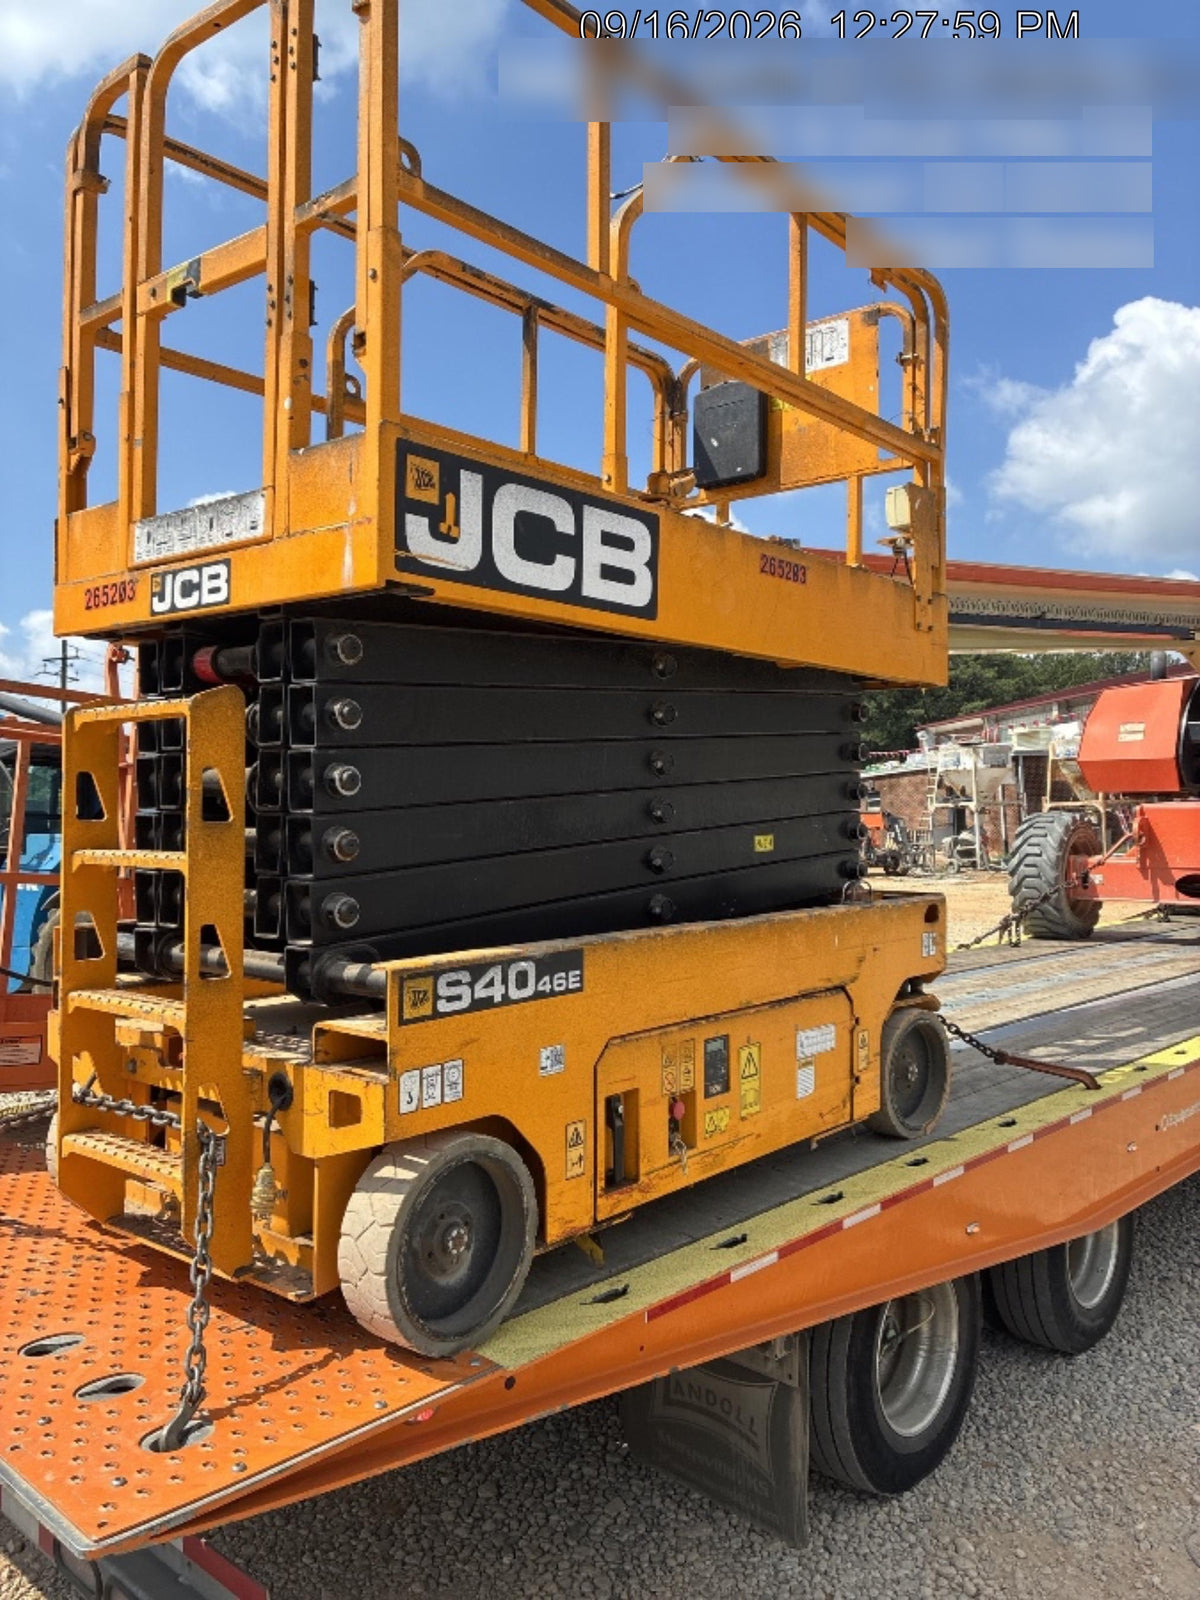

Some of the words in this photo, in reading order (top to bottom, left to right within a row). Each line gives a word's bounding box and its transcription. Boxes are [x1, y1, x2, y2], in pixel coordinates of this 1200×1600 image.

[404, 468, 654, 607] JCB
[152, 563, 228, 613] JCB
[436, 960, 536, 1013] S40
[537, 970, 581, 993] 46E
